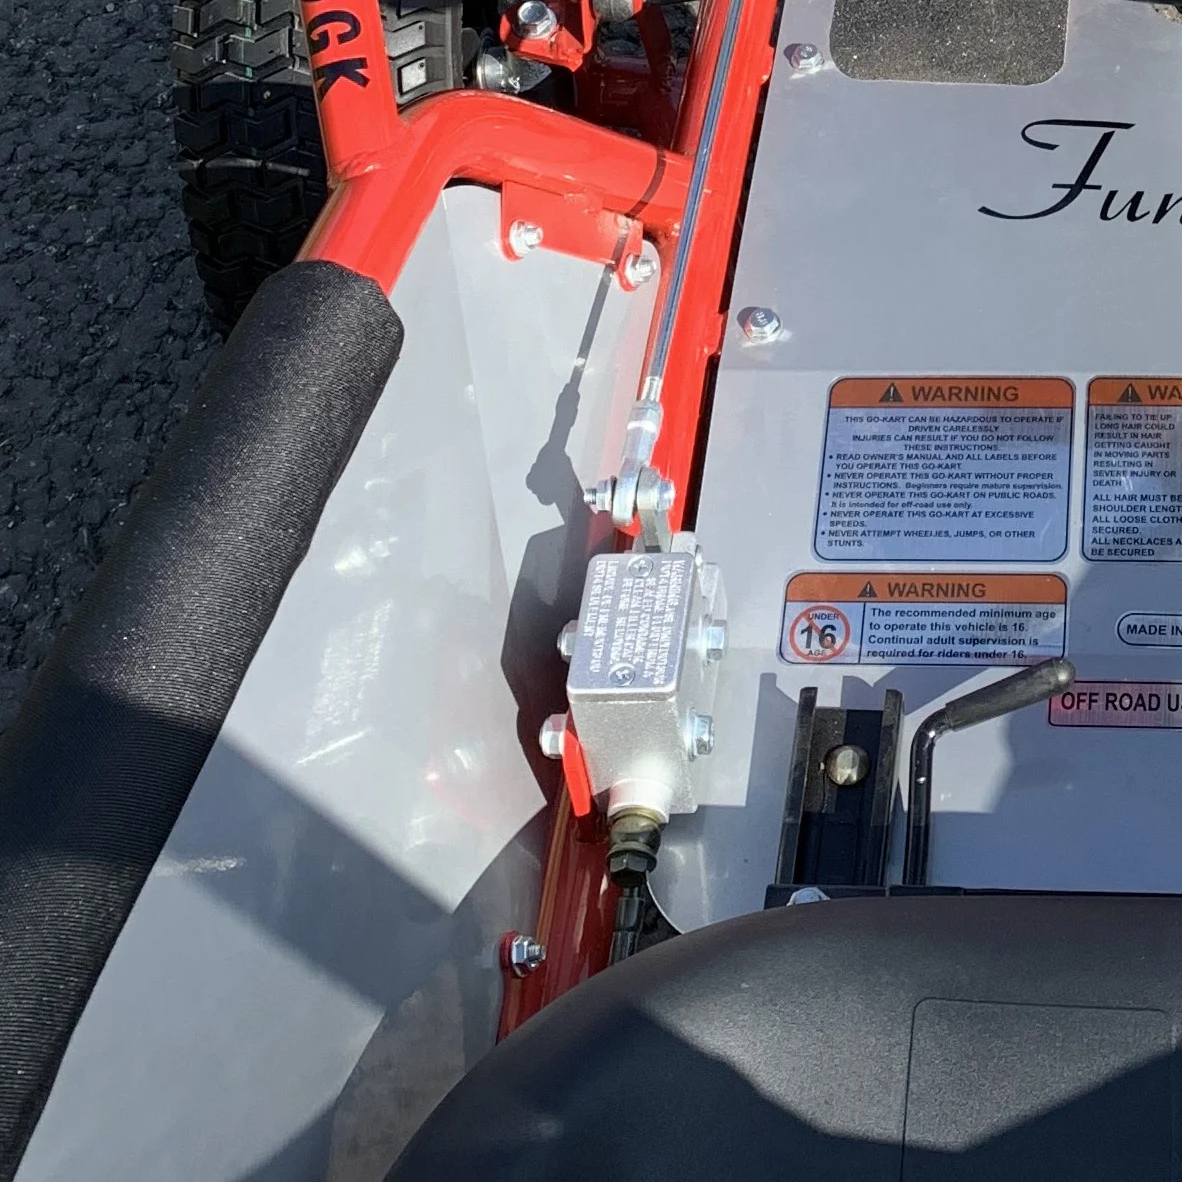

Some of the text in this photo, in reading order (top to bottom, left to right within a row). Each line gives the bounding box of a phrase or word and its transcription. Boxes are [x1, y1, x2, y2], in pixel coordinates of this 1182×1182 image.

[911, 385, 1020, 402] WARNING
[836, 453, 1058, 461] READ OWNER'S MANUAL AND ALL LABELS BEFORE
[931, 472, 972, 480] GO-KART
[974, 472, 1015, 480] WITHOUT
[1016, 472, 1054, 480] PROPER
[1092, 494, 1111, 502] ALL
[1113, 494, 1137, 502] HAIR
[1139, 494, 1167, 502] MUST
[1092, 505, 1146, 513] SHOULDER
[1092, 516, 1110, 524] ALL
[1113, 516, 1146, 524] LOOSE
[828, 529, 858, 537] NEVER
[860, 529, 901, 538] ATTEMPT
[988, 530, 1002, 538] OR
[1004, 530, 1036, 539] OTHER
[1112, 538, 1173, 546] NECKLACES
[887, 582, 987, 598] WARNING
[870, 607, 1056, 620] The recommended minimum age
[869, 621, 881, 630] to
[883, 622, 927, 631] operate
[930, 621, 950, 631] this
[954, 621, 995, 631] vehicle
[998, 622, 1008, 631] is
[1126, 624, 1166, 636] MADE
[800, 621, 837, 652] 16
[868, 634, 1039, 646] Continual adult supervision is
[866, 648, 915, 658] required
[917, 648, 934, 657] for
[936, 648, 971, 658] riders
[973, 649, 1006, 658] under
[1061, 692, 1098, 711] OFF
[1105, 692, 1160, 712] ROAD
